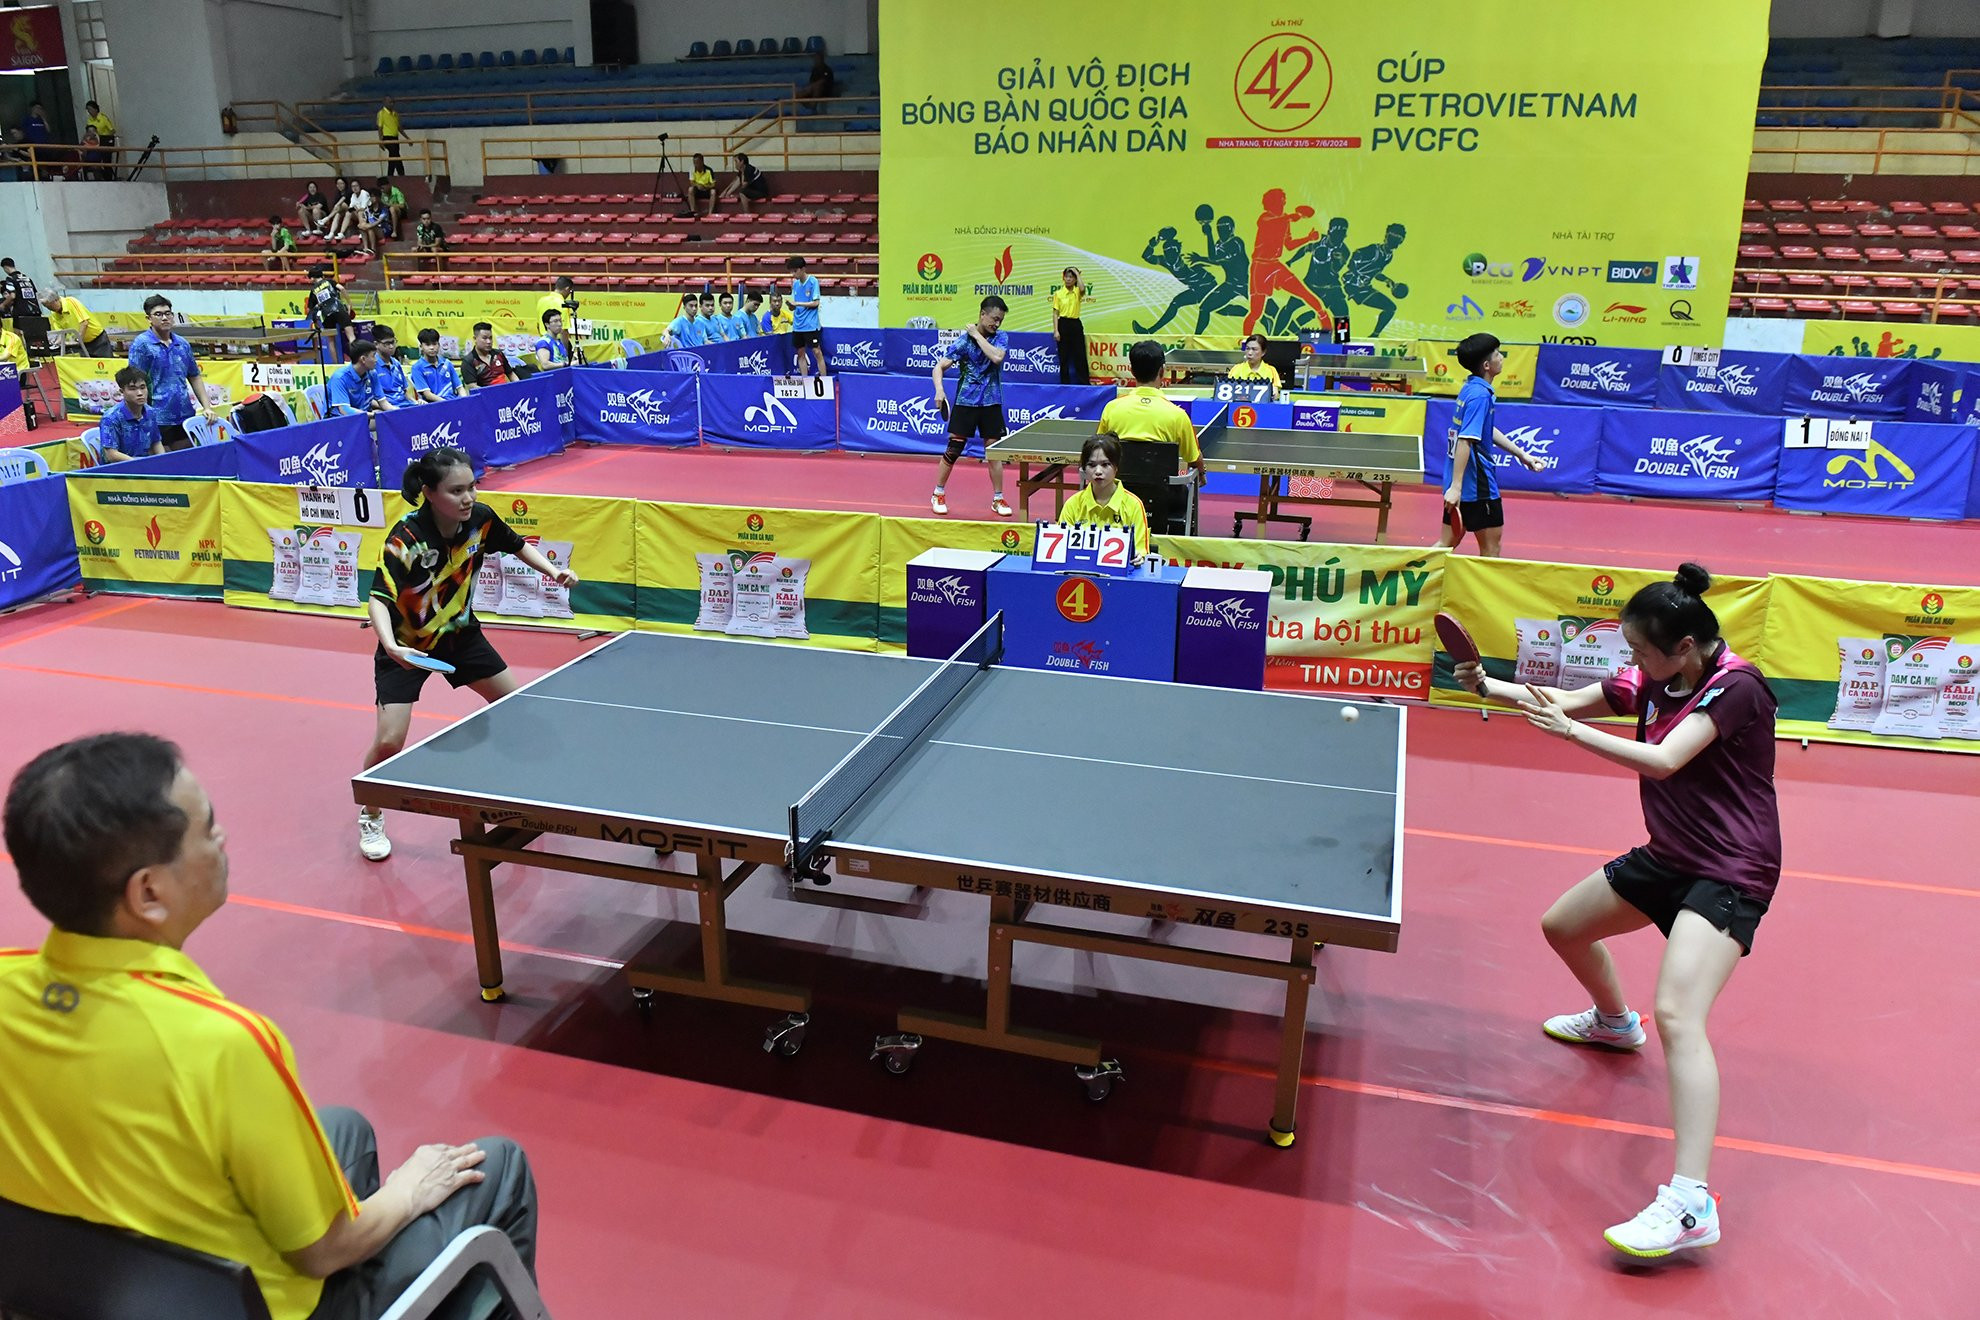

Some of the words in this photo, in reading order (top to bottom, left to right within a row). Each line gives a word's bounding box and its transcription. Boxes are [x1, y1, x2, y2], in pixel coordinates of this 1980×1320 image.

[998, 57, 1055, 90] GIẢI
[1067, 56, 1105, 89] VÔ
[1116, 62, 1190, 93] ĐỊCH
[1377, 50, 1446, 84] CÚP
[1243, 45, 1314, 110] 42
[901, 95, 976, 125] BÓNG
[984, 93, 1040, 123] BÀN
[1049, 85, 1129, 122] QUỐC
[1139, 96, 1188, 120] GIA
[1374, 92, 1638, 118] PETROVIETNAM
[974, 124, 1029, 155] BÁO
[1038, 122, 1117, 154] NHÂN
[1127, 121, 1187, 153] DÂN
[1235, 140, 1261, 148] TRANG,
[1372, 127, 1479, 152] PVCFC
[955, 226, 971, 235] NHÀ
[999, 226, 1022, 235] HÀNH
[1552, 231, 1573, 240] NHÀ
[1577, 231, 1591, 240] TÀI
[1472, 261, 1514, 277] BCG
[1548, 266, 1602, 277] VNPT
[1611, 267, 1642, 279] BIDV
[974, 285, 1033, 296] PETROVIETNAM
[1602, 316, 1647, 324] LI-NING
[1089, 342, 1117, 357] NPK
[1672, 346, 1682, 363] 0
[251, 364, 259, 383] 2
[1091, 361, 1113, 371] Cho
[814, 377, 824, 397] 0
[1560, 377, 1598, 390] DOUBLE
[1609, 382, 1631, 392] FISH
[1686, 380, 1725, 393] DOUBLE
[1735, 386, 1758, 396] FISH
[1217, 384, 1232, 401] 8
[1234, 384, 1242, 394] 2
[1252, 385, 1269, 403] 7
[1811, 389, 1850, 403] DOUBLE
[1862, 394, 1883, 403] FISH
[600, 410, 637, 423] DOUBLE
[649, 414, 670, 424] FISH
[1238, 408, 1252, 427] 5
[495, 427, 521, 443] DOUBLE
[527, 421, 542, 434] FISH
[744, 424, 797, 434] MOFIT
[866, 417, 908, 434] DOUBLE
[921, 423, 945, 435] FISH
[1801, 418, 1811, 444] 1
[1850, 430, 1863, 442] NAI
[1373, 473, 1391, 481] 235
[1634, 458, 1691, 477] DOUBLE
[1706, 465, 1740, 480] FISH
[1823, 478, 1915, 490] MOFIT
[335, 510, 340, 519] 2
[353, 492, 370, 523] 0
[198, 539, 216, 549] NPK
[1042, 532, 1064, 560] 7
[1071, 532, 1081, 547] 2
[1088, 533, 1095, 548] 1
[1101, 537, 1125, 564] 2
[134, 549, 180, 561] PETROVIETNAM
[192, 550, 210, 561] PHÚ
[1147, 558, 1158, 573] T
[1257, 556, 1345, 603] PHÚ
[1359, 560, 1430, 606] MỸ
[911, 591, 943, 604] Double
[956, 598, 976, 607] FISH
[1063, 582, 1089, 617] 4
[1186, 615, 1222, 628] Double
[1237, 619, 1259, 630] FISH
[1268, 615, 1303, 640] ùa
[1314, 617, 1361, 647] bội
[1371, 619, 1421, 645] thu
[1046, 655, 1080, 669] DOUBLE
[1088, 660, 1110, 671] FISH
[1527, 660, 1555, 669] DAP
[1300, 664, 1340, 685] TIN
[1348, 664, 1423, 689] DÙNG
[1850, 680, 1879, 690] DAP
[1944, 685, 1975, 695] KALI
[521, 818, 554, 831] Double
[556, 825, 577, 834] FISH
[601, 823, 748, 859] MOFIT
[956, 873, 1112, 912] 世乒赛器材供应商
[1263, 918, 1309, 938] 235
